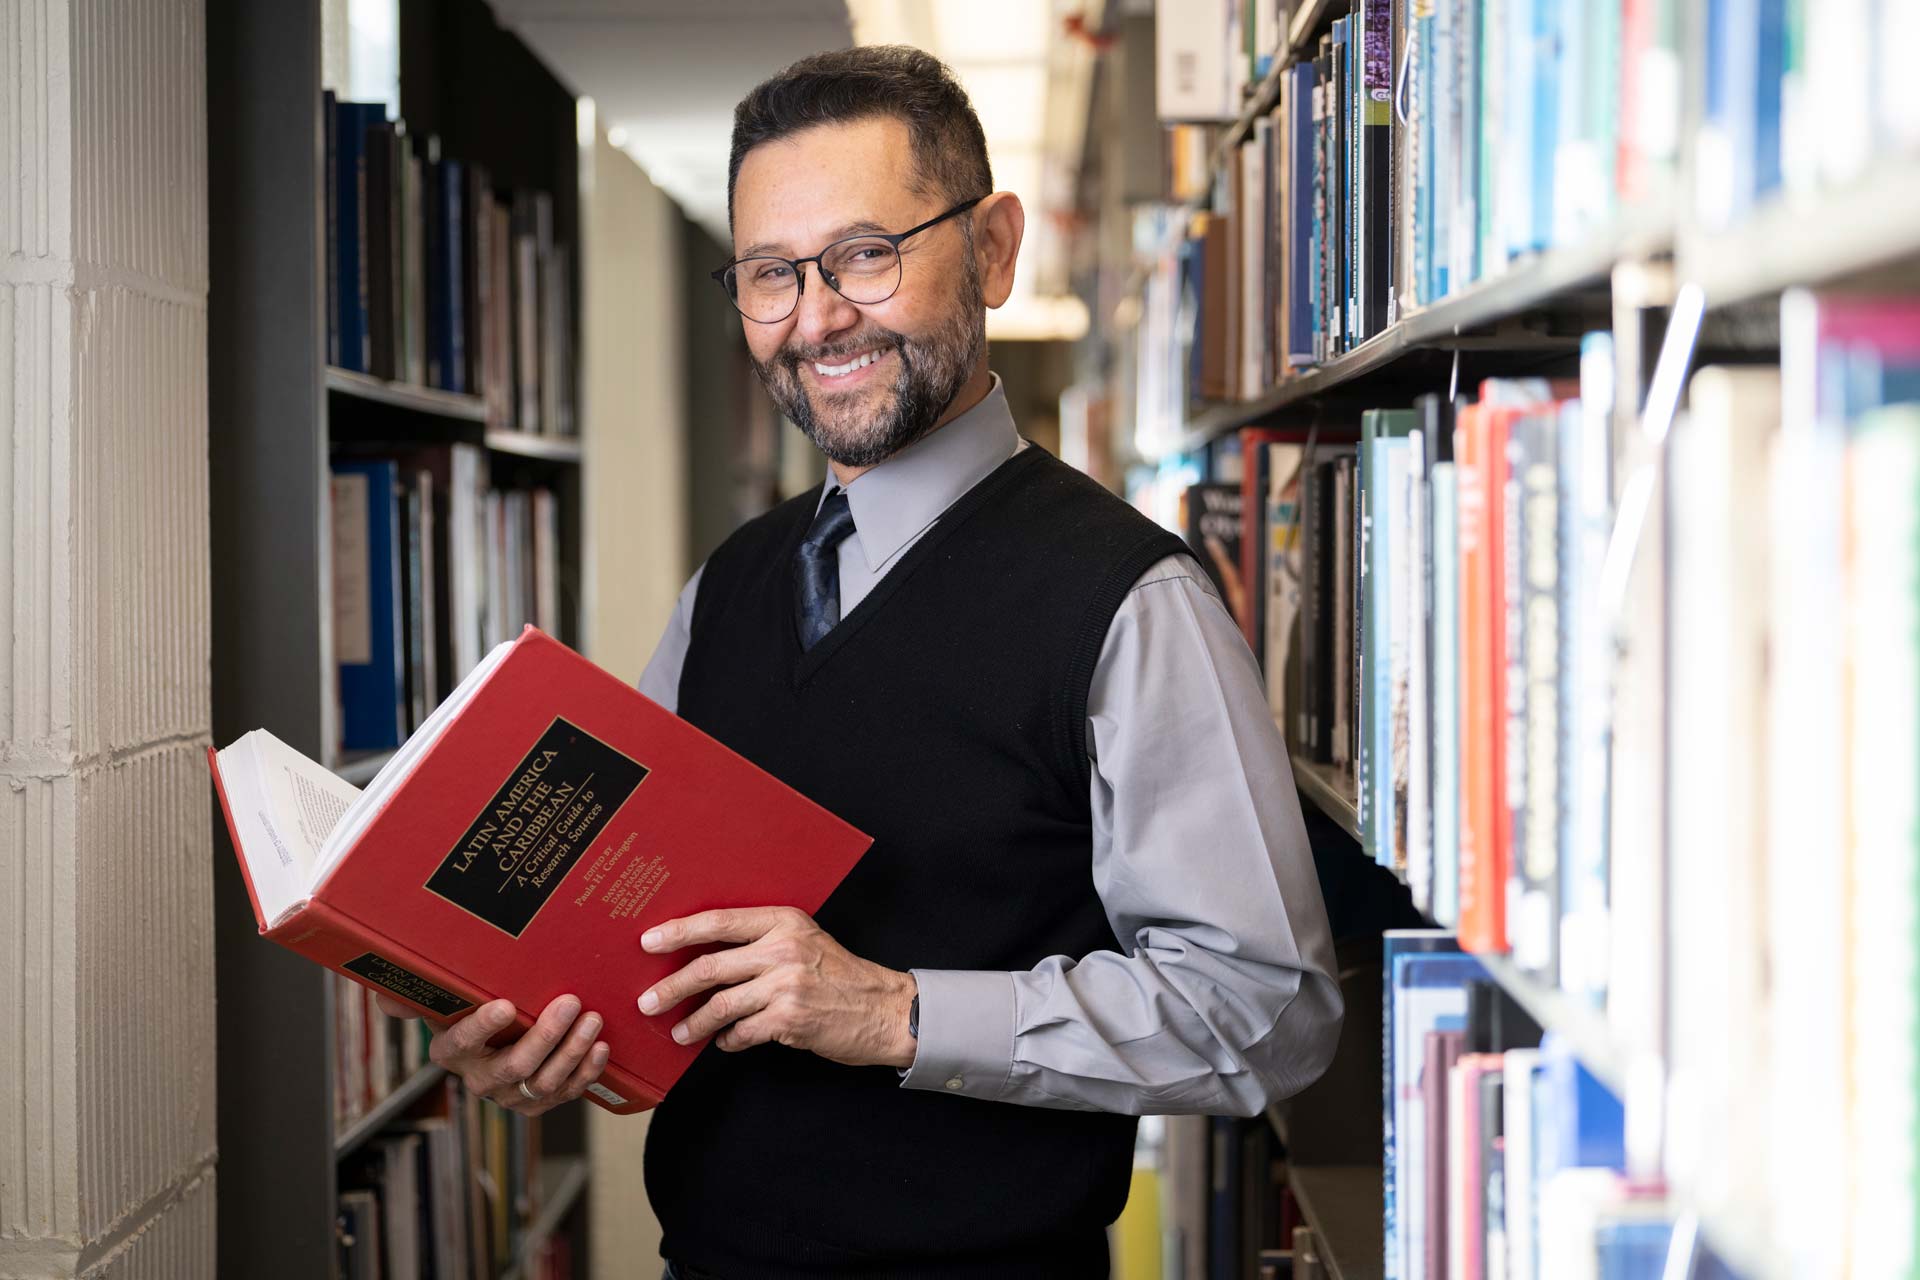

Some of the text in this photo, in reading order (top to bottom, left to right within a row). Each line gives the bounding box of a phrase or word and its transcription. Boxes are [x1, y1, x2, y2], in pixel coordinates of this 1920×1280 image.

[452, 749, 559, 873] LATIN AMERICA
[491, 781, 553, 857] AND THE
[498, 781, 575, 872] CARIBBEAN
[516, 790, 594, 887] A Critical Guide to
[531, 803, 603, 888] Research Sources
[574, 831, 639, 907] Paula H. Covington
[583, 845, 613, 881] EDITED BY
[602, 880, 623, 903] DAVID
[609, 897, 628, 919] PETER
[633, 855, 664, 891] JOHNSON,
[610, 887, 626, 904] DAN
[620, 886, 650, 917] BARBARA
[367, 972, 435, 1006] CARIBBEAN
[371, 958, 461, 1005] LATIN AMERICA
[384, 971, 434, 999] AND THE
